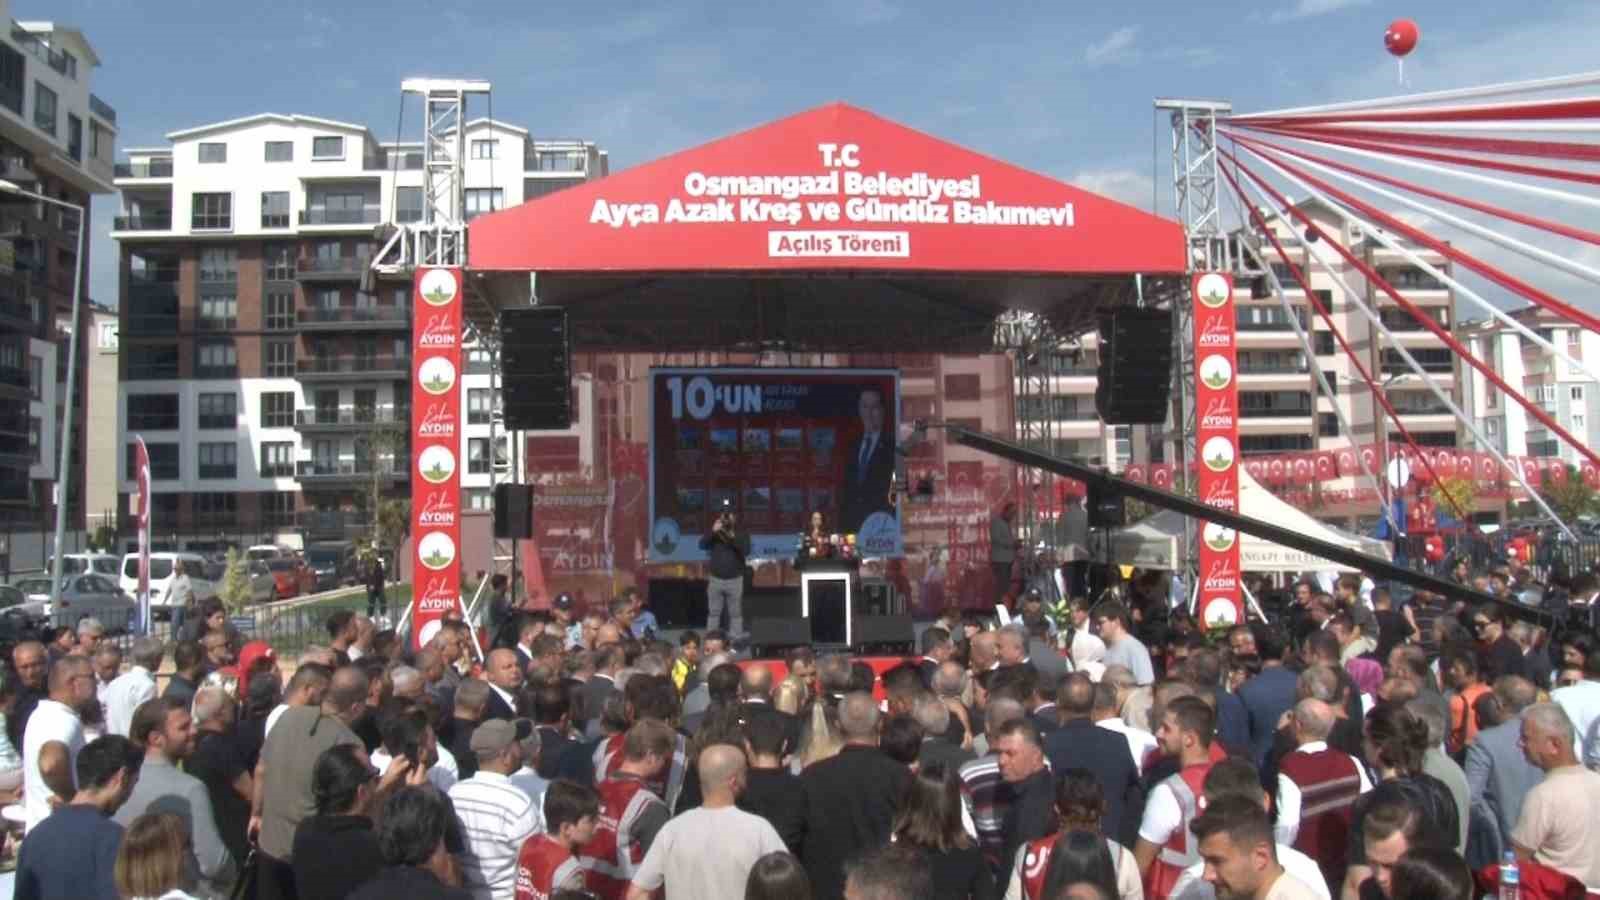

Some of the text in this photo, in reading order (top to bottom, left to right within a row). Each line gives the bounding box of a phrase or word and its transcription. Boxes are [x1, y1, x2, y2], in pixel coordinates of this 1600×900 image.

[818, 143, 860, 167] T.C
[685, 171, 981, 201] Osmangazi Belediyesi
[589, 198, 1075, 227] Ayça Azak Kreş ve Gündüz Bakımevi
[777, 235, 901, 254] Açılış Töreni
[419, 334, 455, 345] AYDIN
[1199, 333, 1230, 345] AYDIN
[1201, 415, 1232, 426] AYDIN
[419, 423, 454, 433] AYDIN
[419, 511, 454, 522] AYDIN
[1205, 577, 1236, 589] AYDIN
[419, 599, 455, 610] AYDIN
